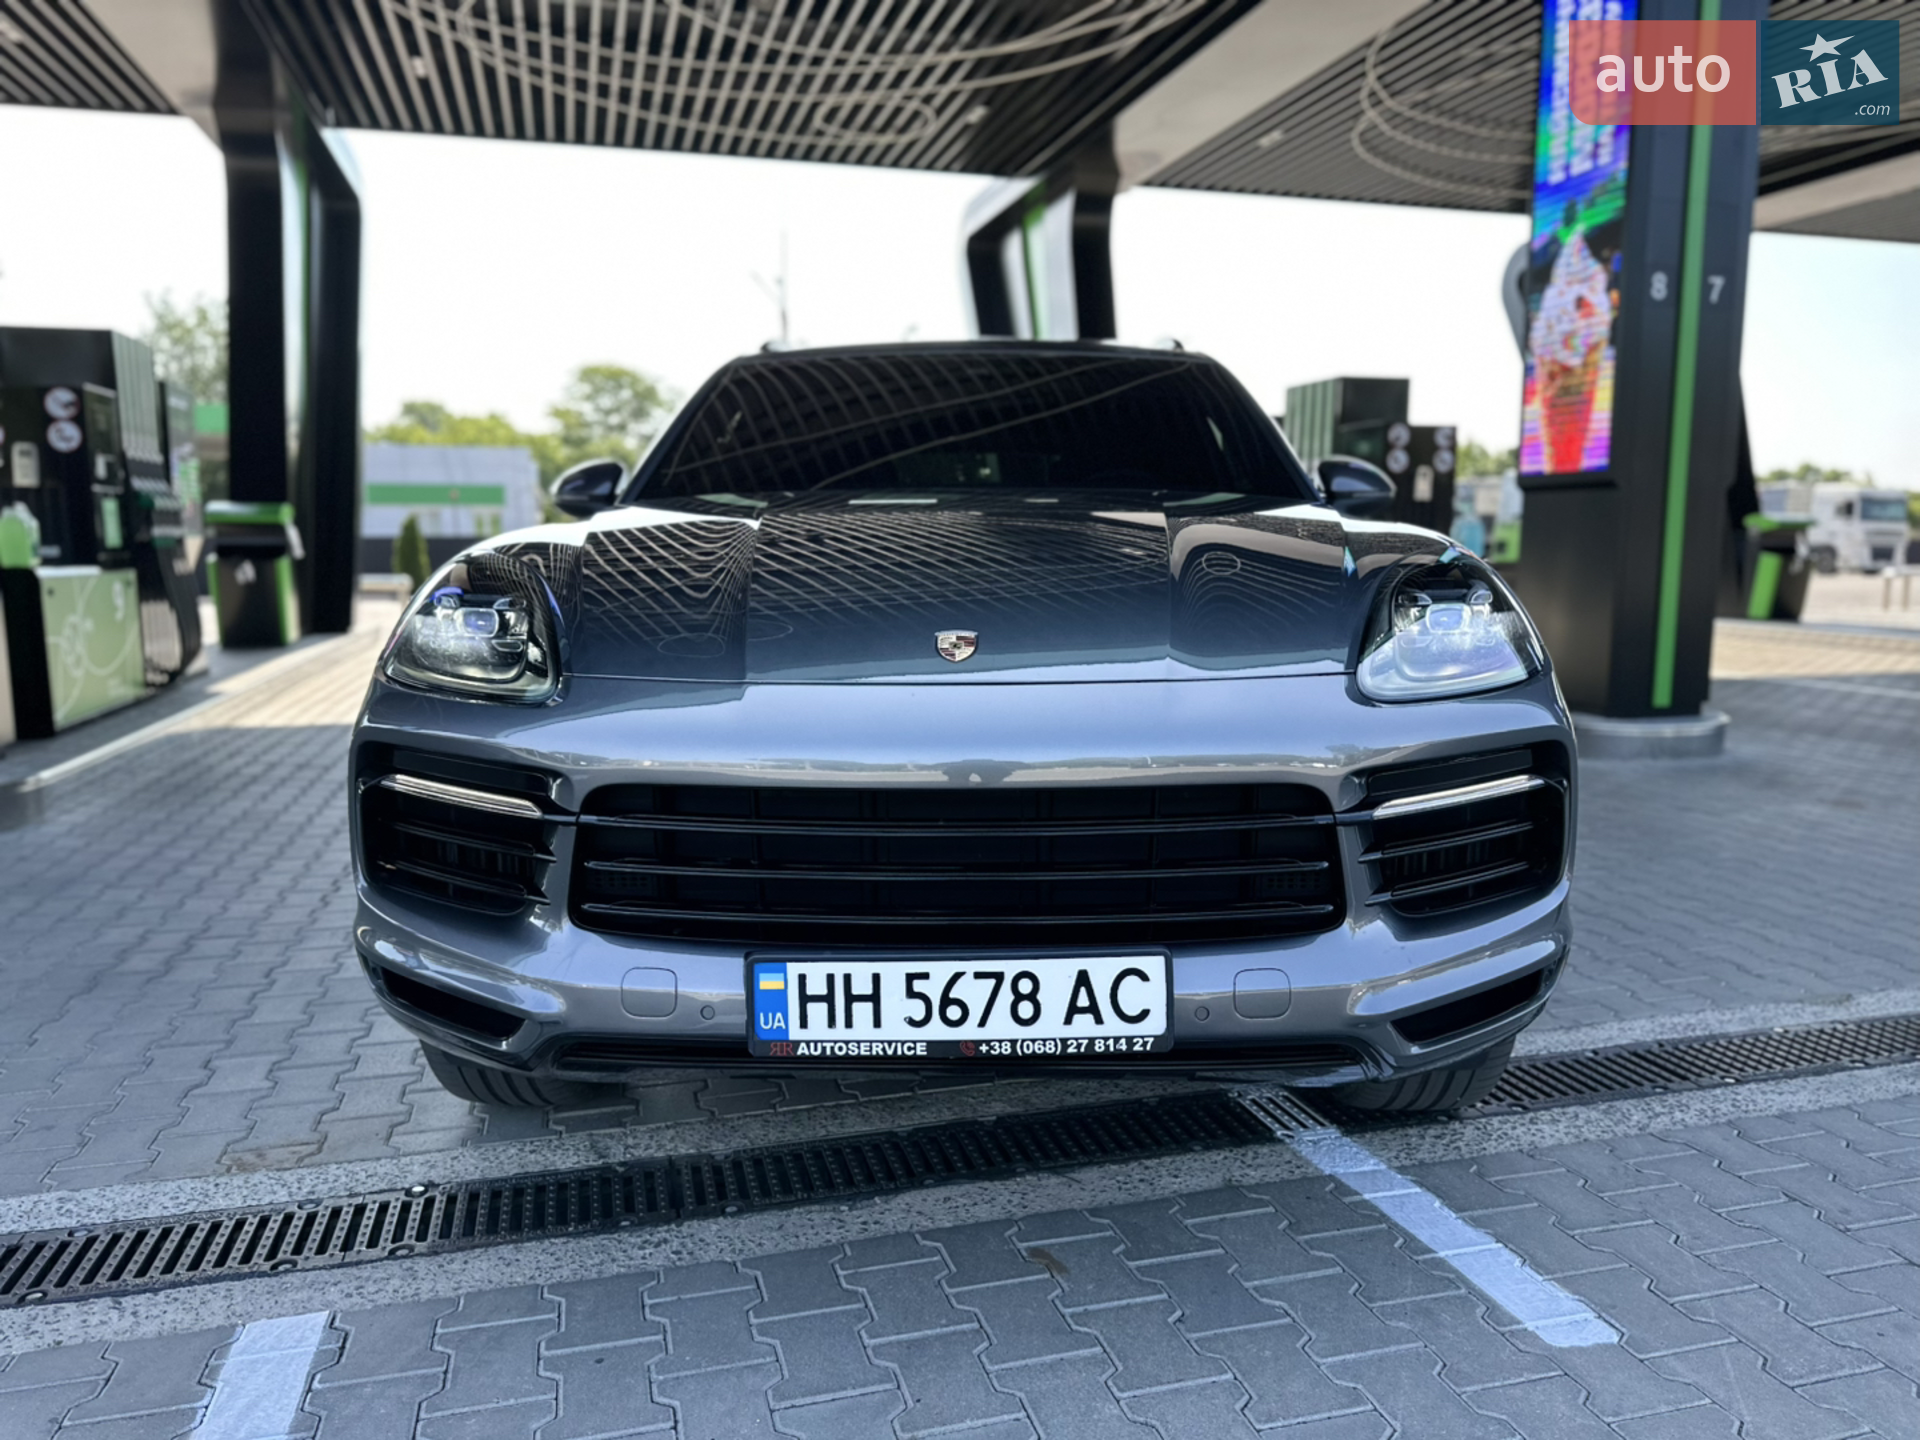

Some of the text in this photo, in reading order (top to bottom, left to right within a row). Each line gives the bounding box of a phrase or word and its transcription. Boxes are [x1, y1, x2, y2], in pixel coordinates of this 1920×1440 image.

[1651, 271, 1668, 301] 8
[1707, 275, 1725, 304] 7
[798, 967, 1151, 1029] HH 5678 AC
[760, 1012, 786, 1030] UA
[797, 1042, 927, 1056] AUTOSERVICE
[979, 1037, 1154, 1056] +38 (068) 27 814 27
